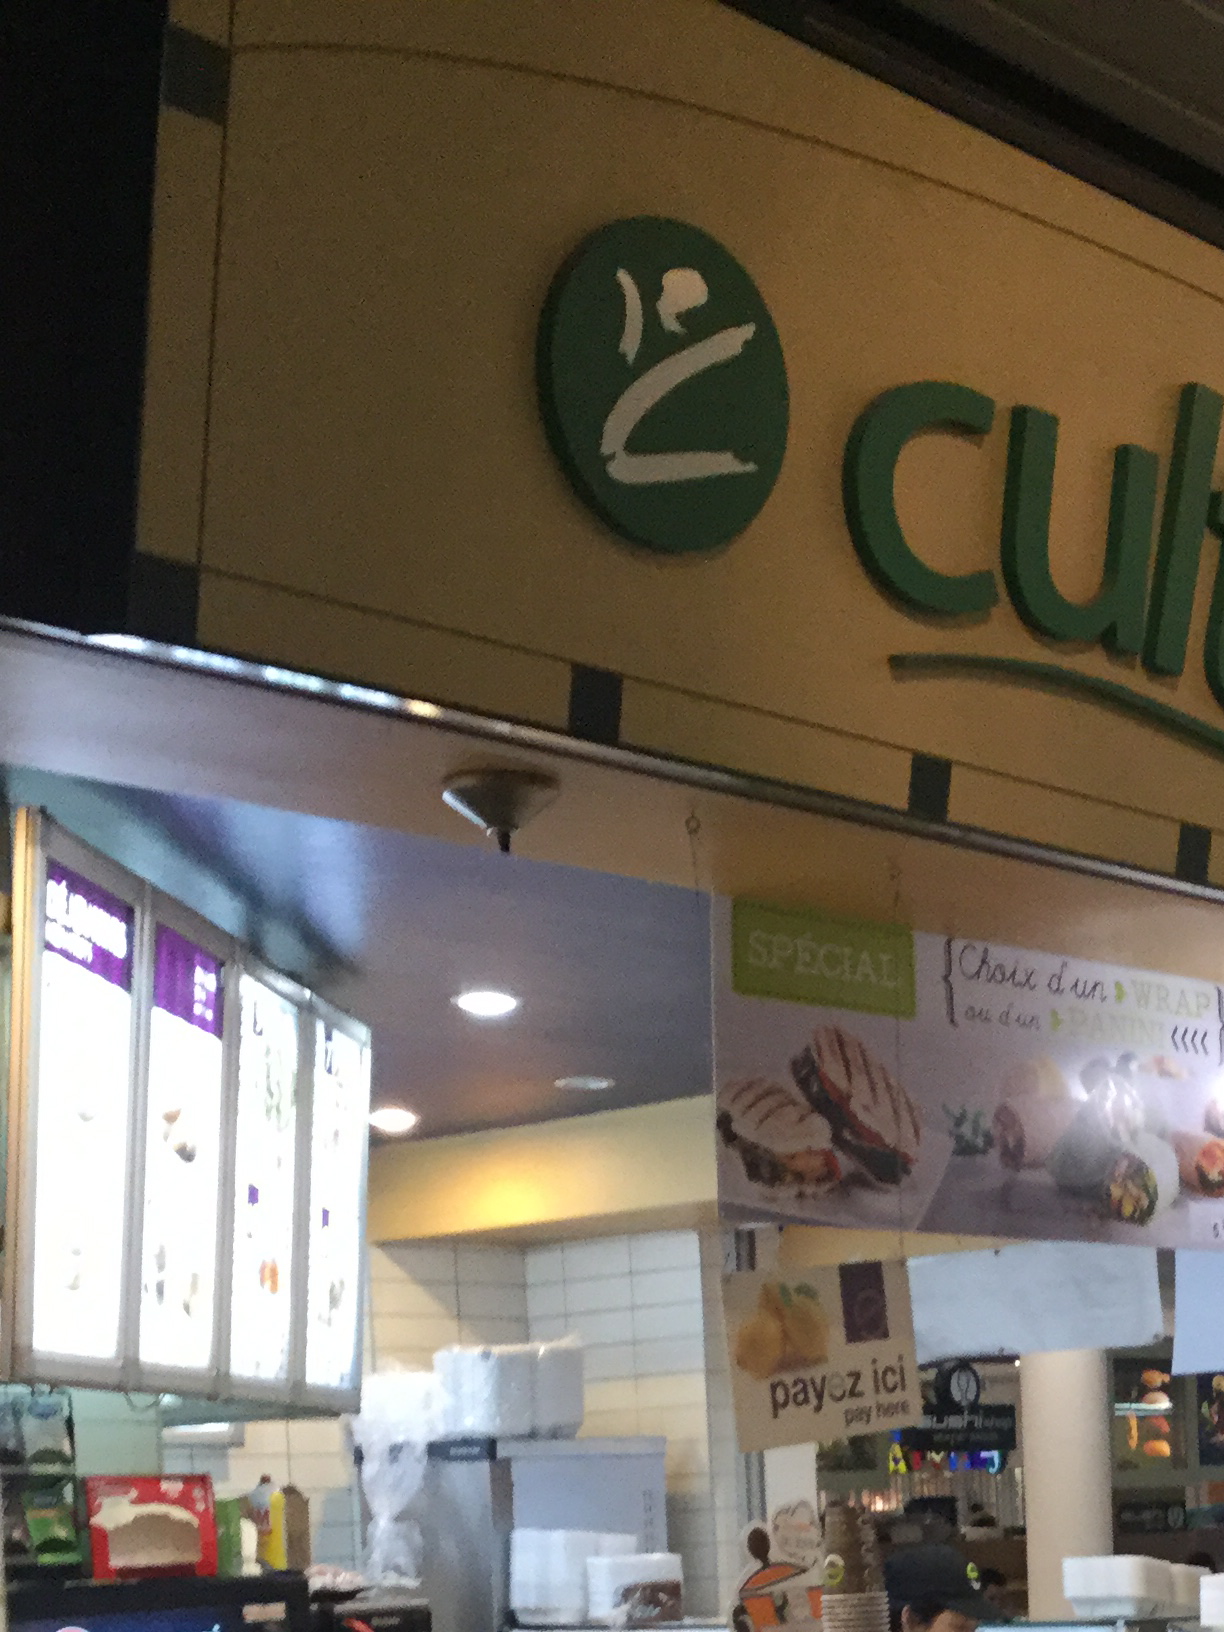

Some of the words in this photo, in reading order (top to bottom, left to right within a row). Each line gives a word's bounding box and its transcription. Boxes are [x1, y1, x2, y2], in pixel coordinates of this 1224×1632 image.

[958, 941, 1038, 992] Choix
[1130, 977, 1211, 1020] WRAP
[964, 1004, 992, 1024] ou
[769, 1368, 865, 1420] payez
[870, 1353, 907, 1396] ici
[843, 1405, 873, 1428] pay
